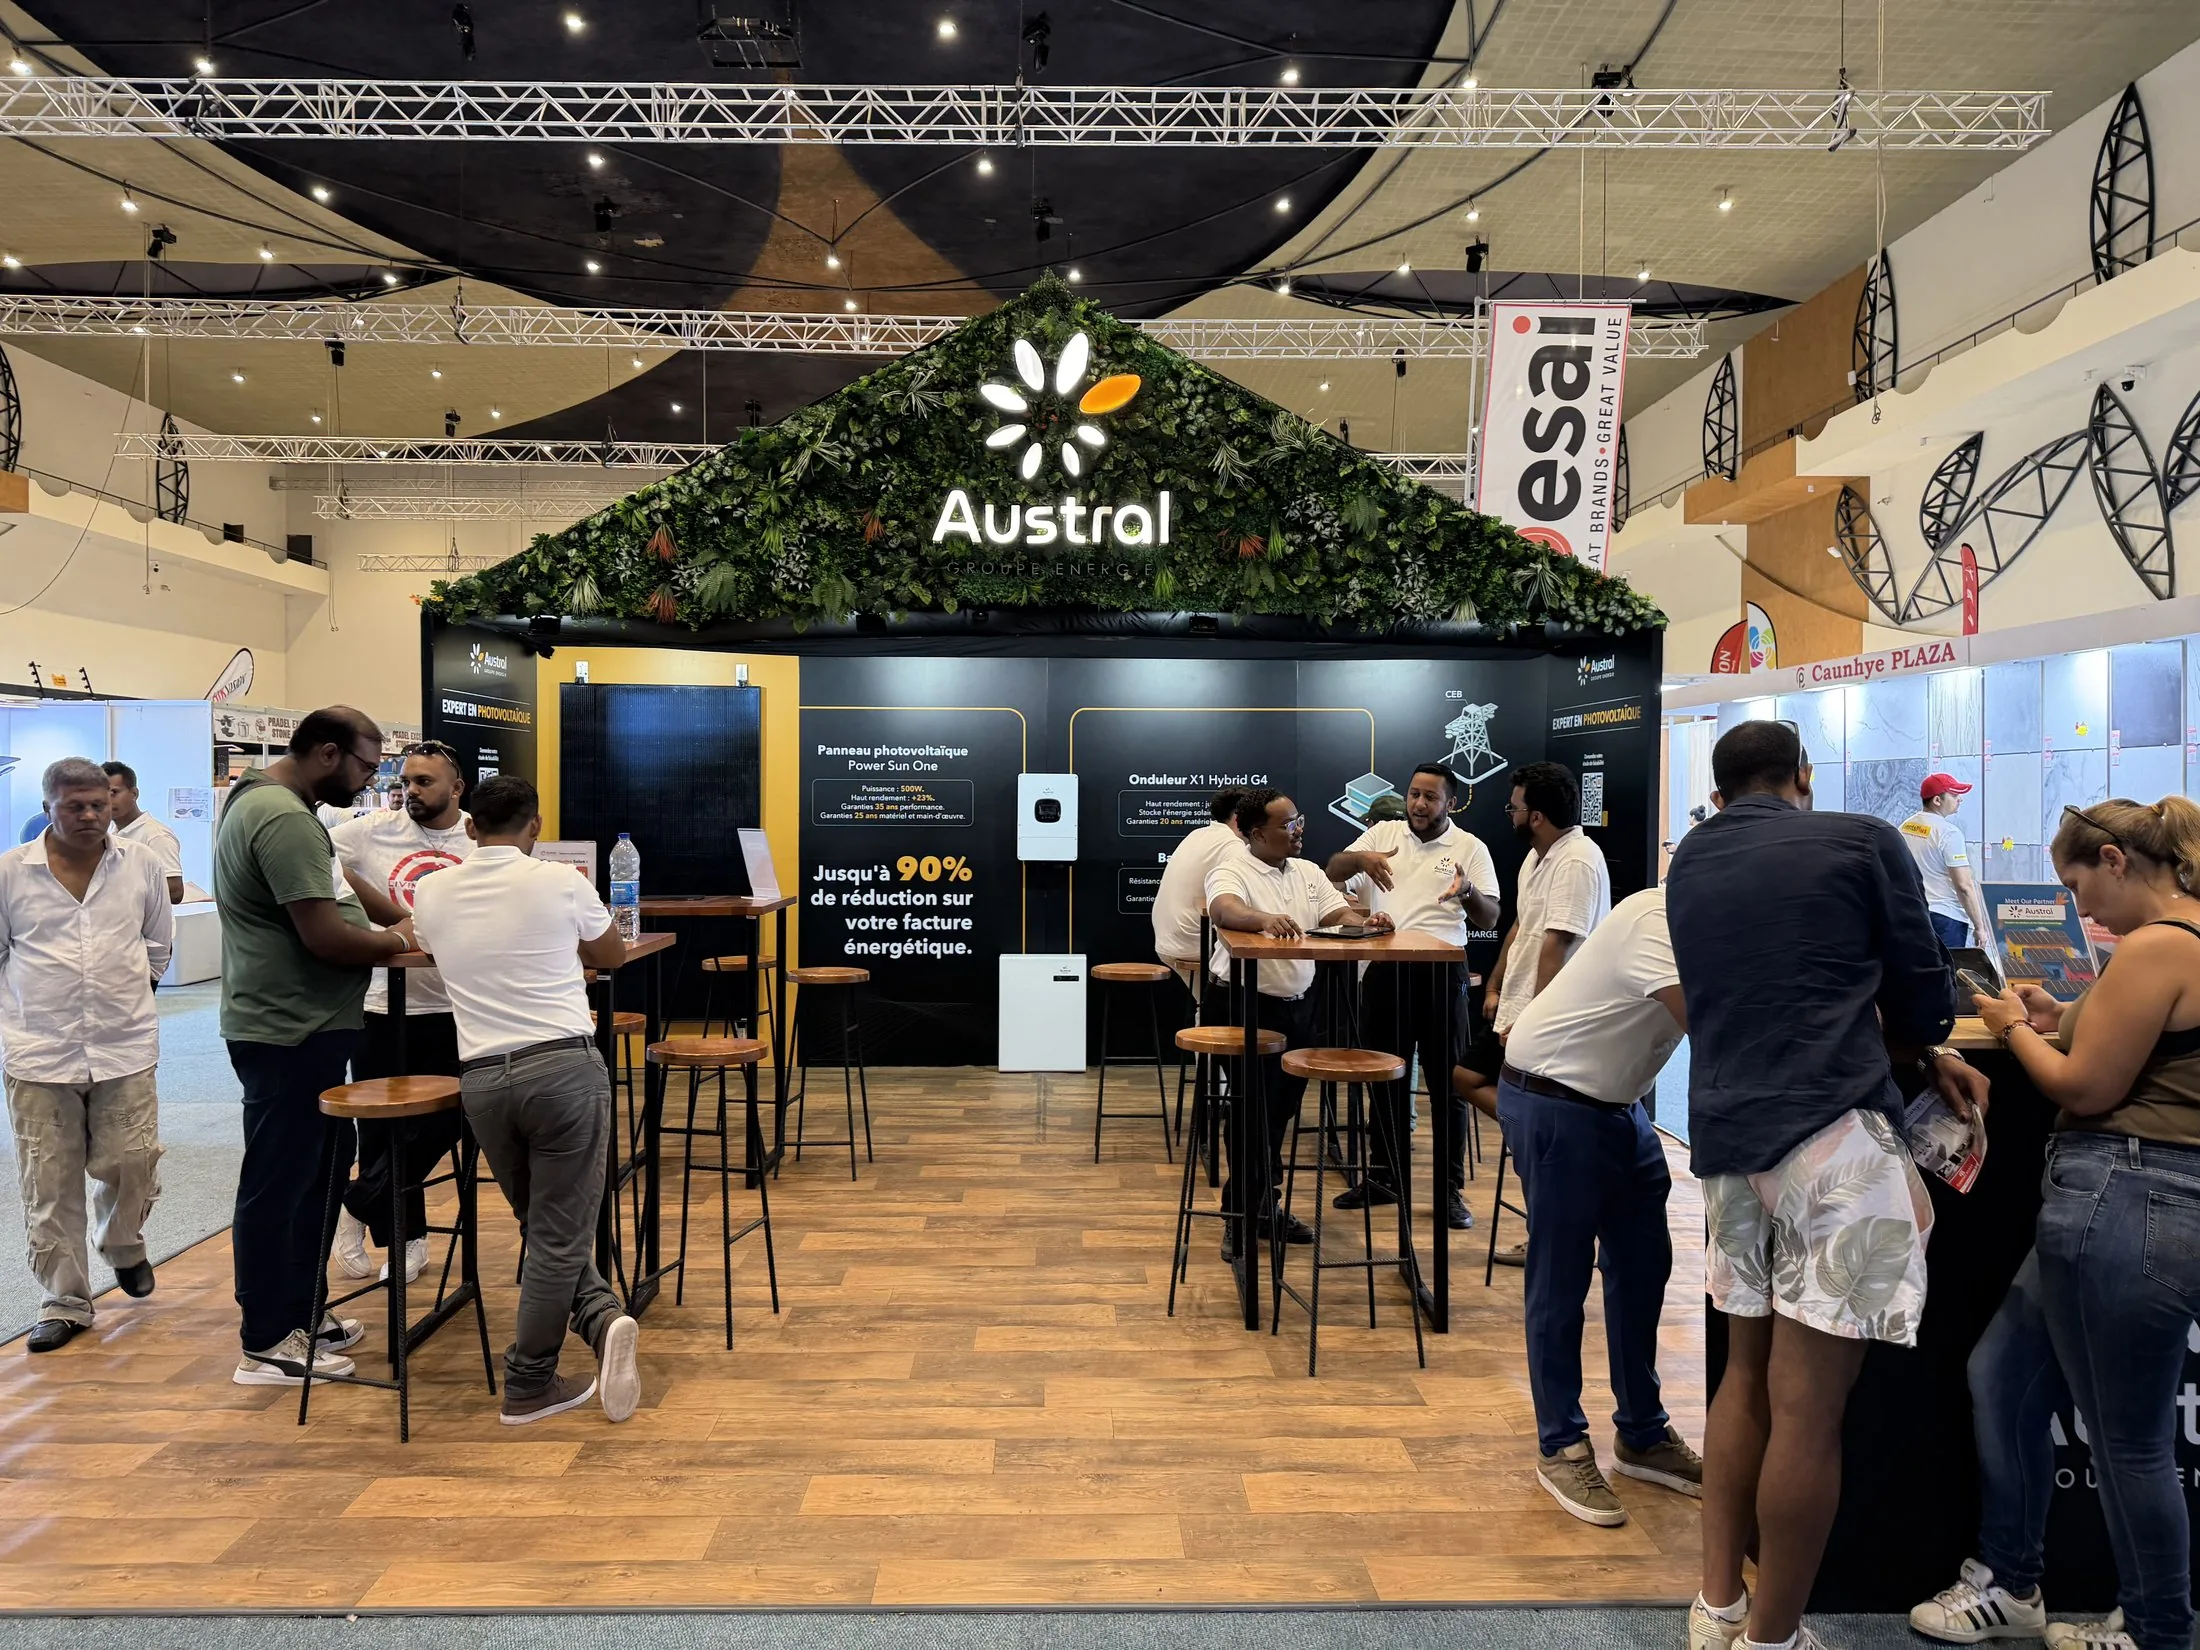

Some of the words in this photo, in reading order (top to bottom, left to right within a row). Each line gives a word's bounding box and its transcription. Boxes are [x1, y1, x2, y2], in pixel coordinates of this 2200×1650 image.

[1603, 317, 1622, 374] VALUE
[1597, 384, 1615, 443] GREAT
[1590, 458, 1609, 533] BRANDS
[932, 489, 1170, 545] Austral
[946, 561, 1040, 576] GROUPE
[1056, 562, 1153, 577] ENERGE
[484, 652, 507, 670] Austral
[1591, 654, 1615, 674] Austral
[1718, 650, 1731, 673] ON
[1812, 657, 1885, 683] Caunhye
[1892, 642, 1956, 670] PLAZA
[1445, 691, 1463, 699] CEB
[442, 698, 468, 715] EXPERT
[468, 703, 478, 717] EN
[478, 707, 531, 725] PHOTOVOLTAÏQUE
[1552, 715, 1574, 730] EXPERT
[1574, 714, 1583, 727] EN
[1583, 704, 1641, 726] PHOTOVOLTAÏQUE
[268, 717, 290, 728] PRADEL
[272, 728, 291, 739] STONE
[410, 732, 422, 741] EXCE
[817, 745, 871, 756] Panneau
[874, 744, 968, 759] photovoltaïque
[848, 761, 885, 771] Power
[888, 761, 910, 771] Sun
[913, 761, 938, 771] One
[1129, 774, 1187, 786] Onduleur
[1190, 775, 1204, 785] X1
[1209, 774, 1247, 788] Hybrid
[1250, 775, 1268, 786] G4
[900, 803, 945, 812] performance.
[879, 812, 907, 820] matériel
[812, 864, 890, 885] Jusqu'à
[896, 855, 973, 882] 90%
[811, 889, 836, 906] de
[842, 889, 937, 906] réduction
[942, 894, 973, 906] sur
[2025, 907, 2053, 915] Austral
[845, 915, 898, 930] votre
[903, 914, 972, 930] facture
[1466, 930, 1499, 939] HARGE
[844, 938, 972, 959] énergétique.
